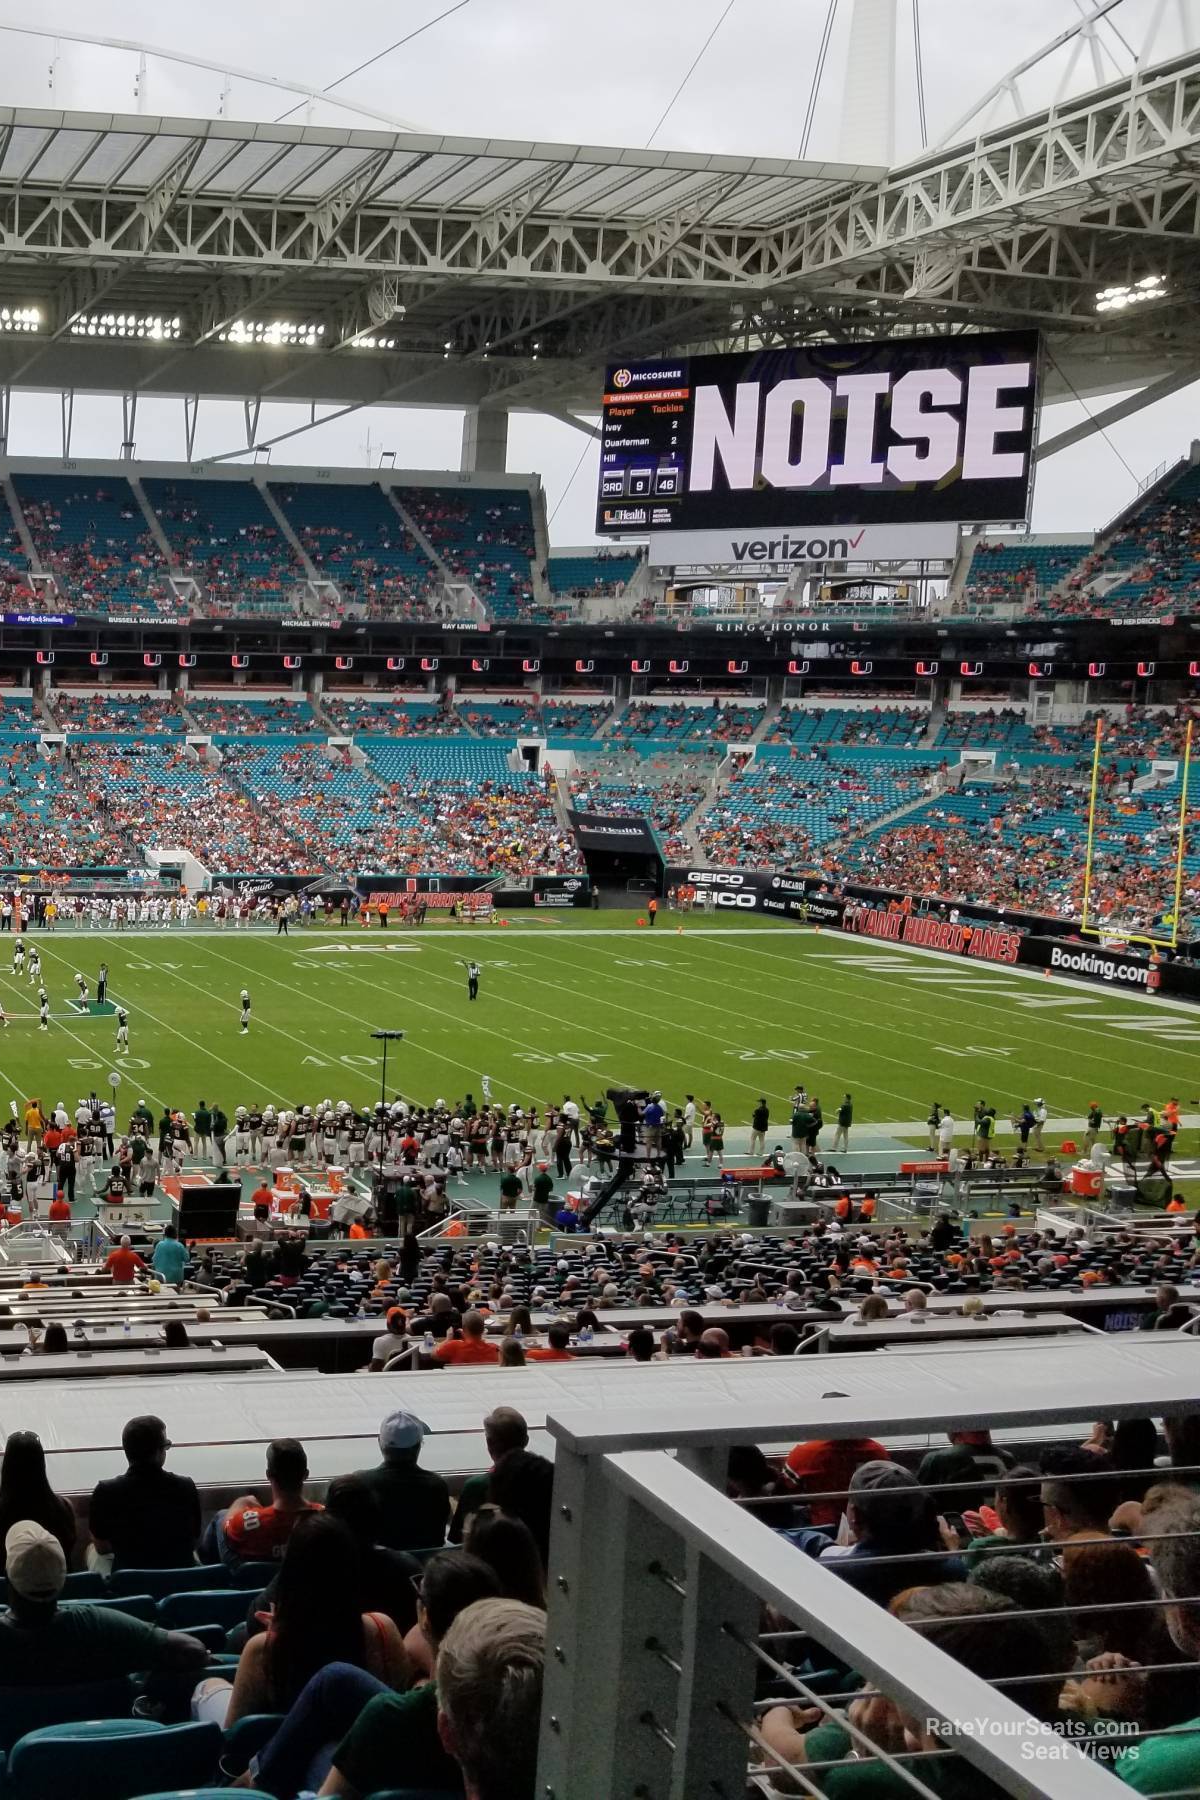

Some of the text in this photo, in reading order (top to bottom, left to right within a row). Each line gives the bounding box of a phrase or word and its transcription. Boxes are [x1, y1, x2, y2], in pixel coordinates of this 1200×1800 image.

[632, 370, 682, 381] MICCOSUKEE
[609, 407, 636, 417] Player
[652, 404, 684, 414] Tackles
[672, 420, 678, 429] 2
[689, 362, 1030, 491] NOISE
[605, 438, 650, 448] Quarterman
[671, 436, 677, 445] 2
[603, 453, 616, 463] Hill
[603, 482, 622, 492] 3RD
[636, 481, 643, 491] 9
[659, 480, 674, 490] 46
[731, 534, 848, 561] verizon
[716, 623, 831, 632] RING HONOR
[688, 871, 744, 884] GEICO
[781, 879, 805, 891] BACARDÍ
[813, 905, 839, 917] Mortgage
[903, 916, 1020, 963] HURRIANES
[301, 943, 422, 953] ACC
[68, 1058, 151, 1069] 50
[111, 1181, 123, 1191] 22
